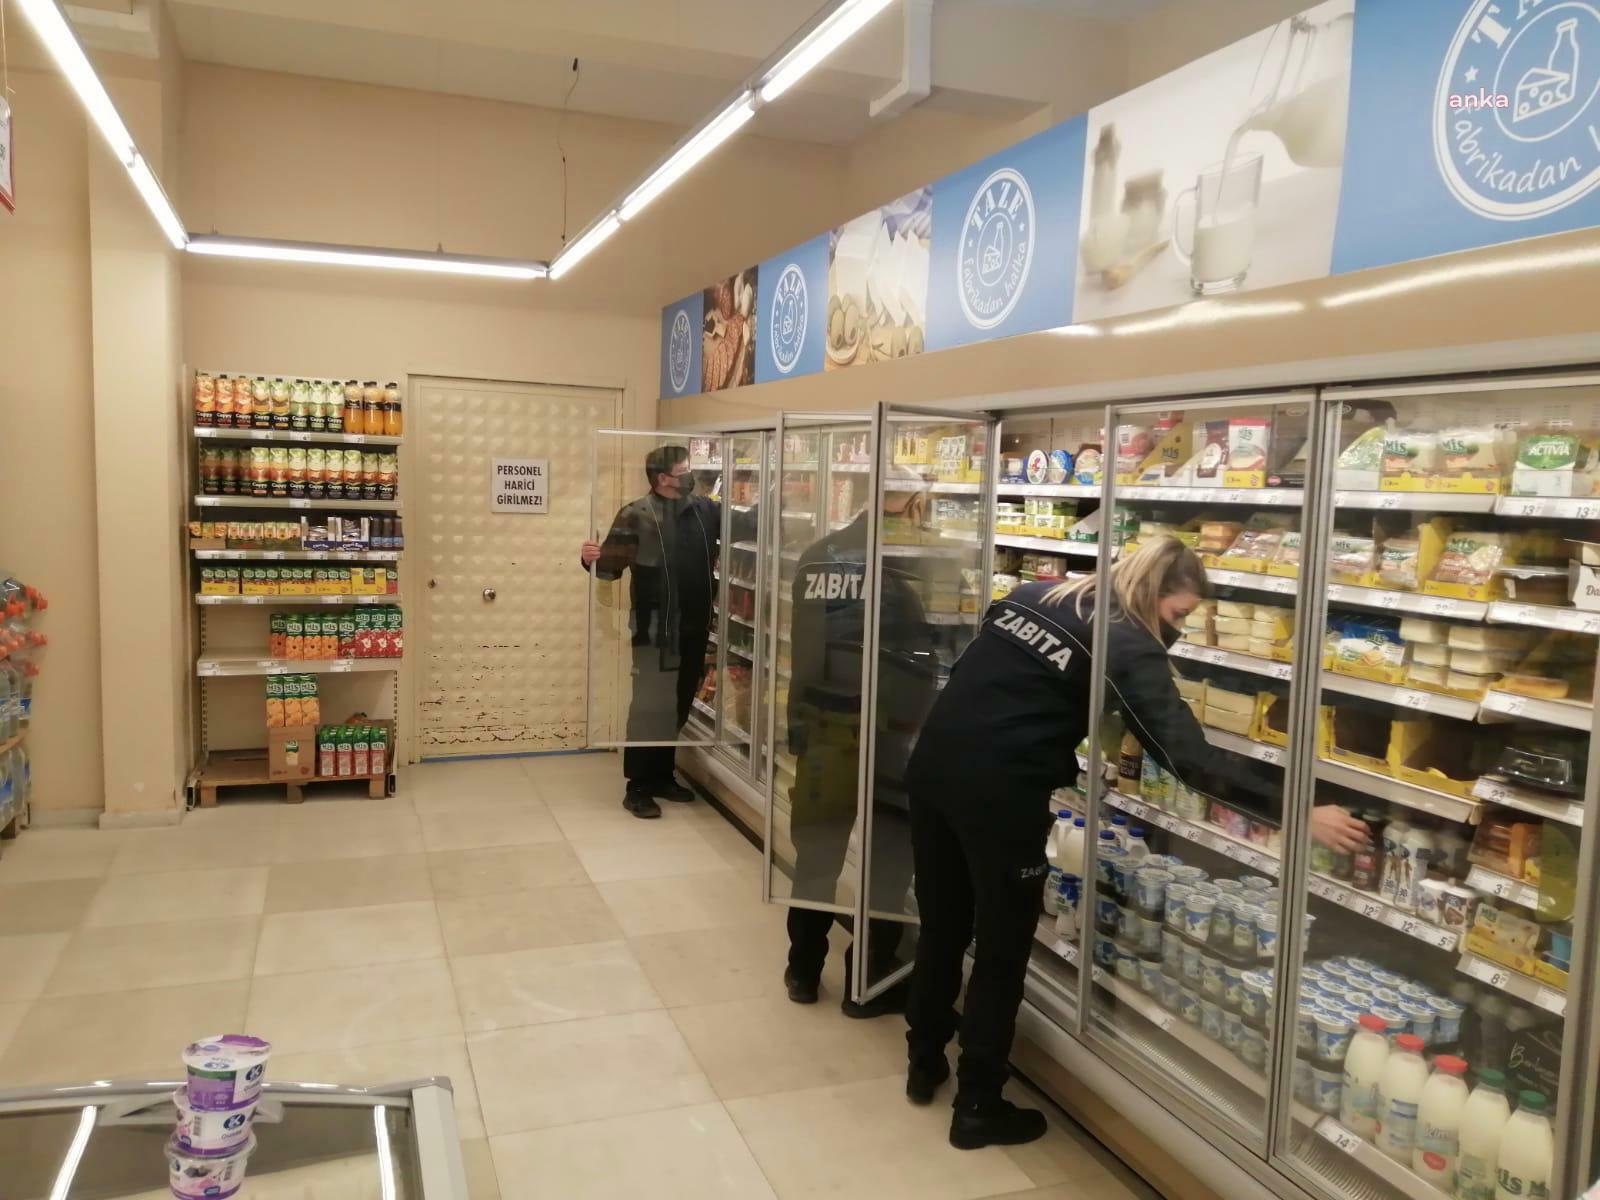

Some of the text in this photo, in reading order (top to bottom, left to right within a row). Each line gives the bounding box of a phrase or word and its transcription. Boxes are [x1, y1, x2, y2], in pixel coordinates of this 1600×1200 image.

[970, 181, 1024, 232] TAZE
[1528, 443, 1570, 457] ACTIVIA
[497, 465, 542, 476] PERSONEL
[504, 479, 535, 490] HARİCİ
[497, 493, 542, 506] GİRİLMEZ!
[993, 608, 1073, 672] ZABITA
